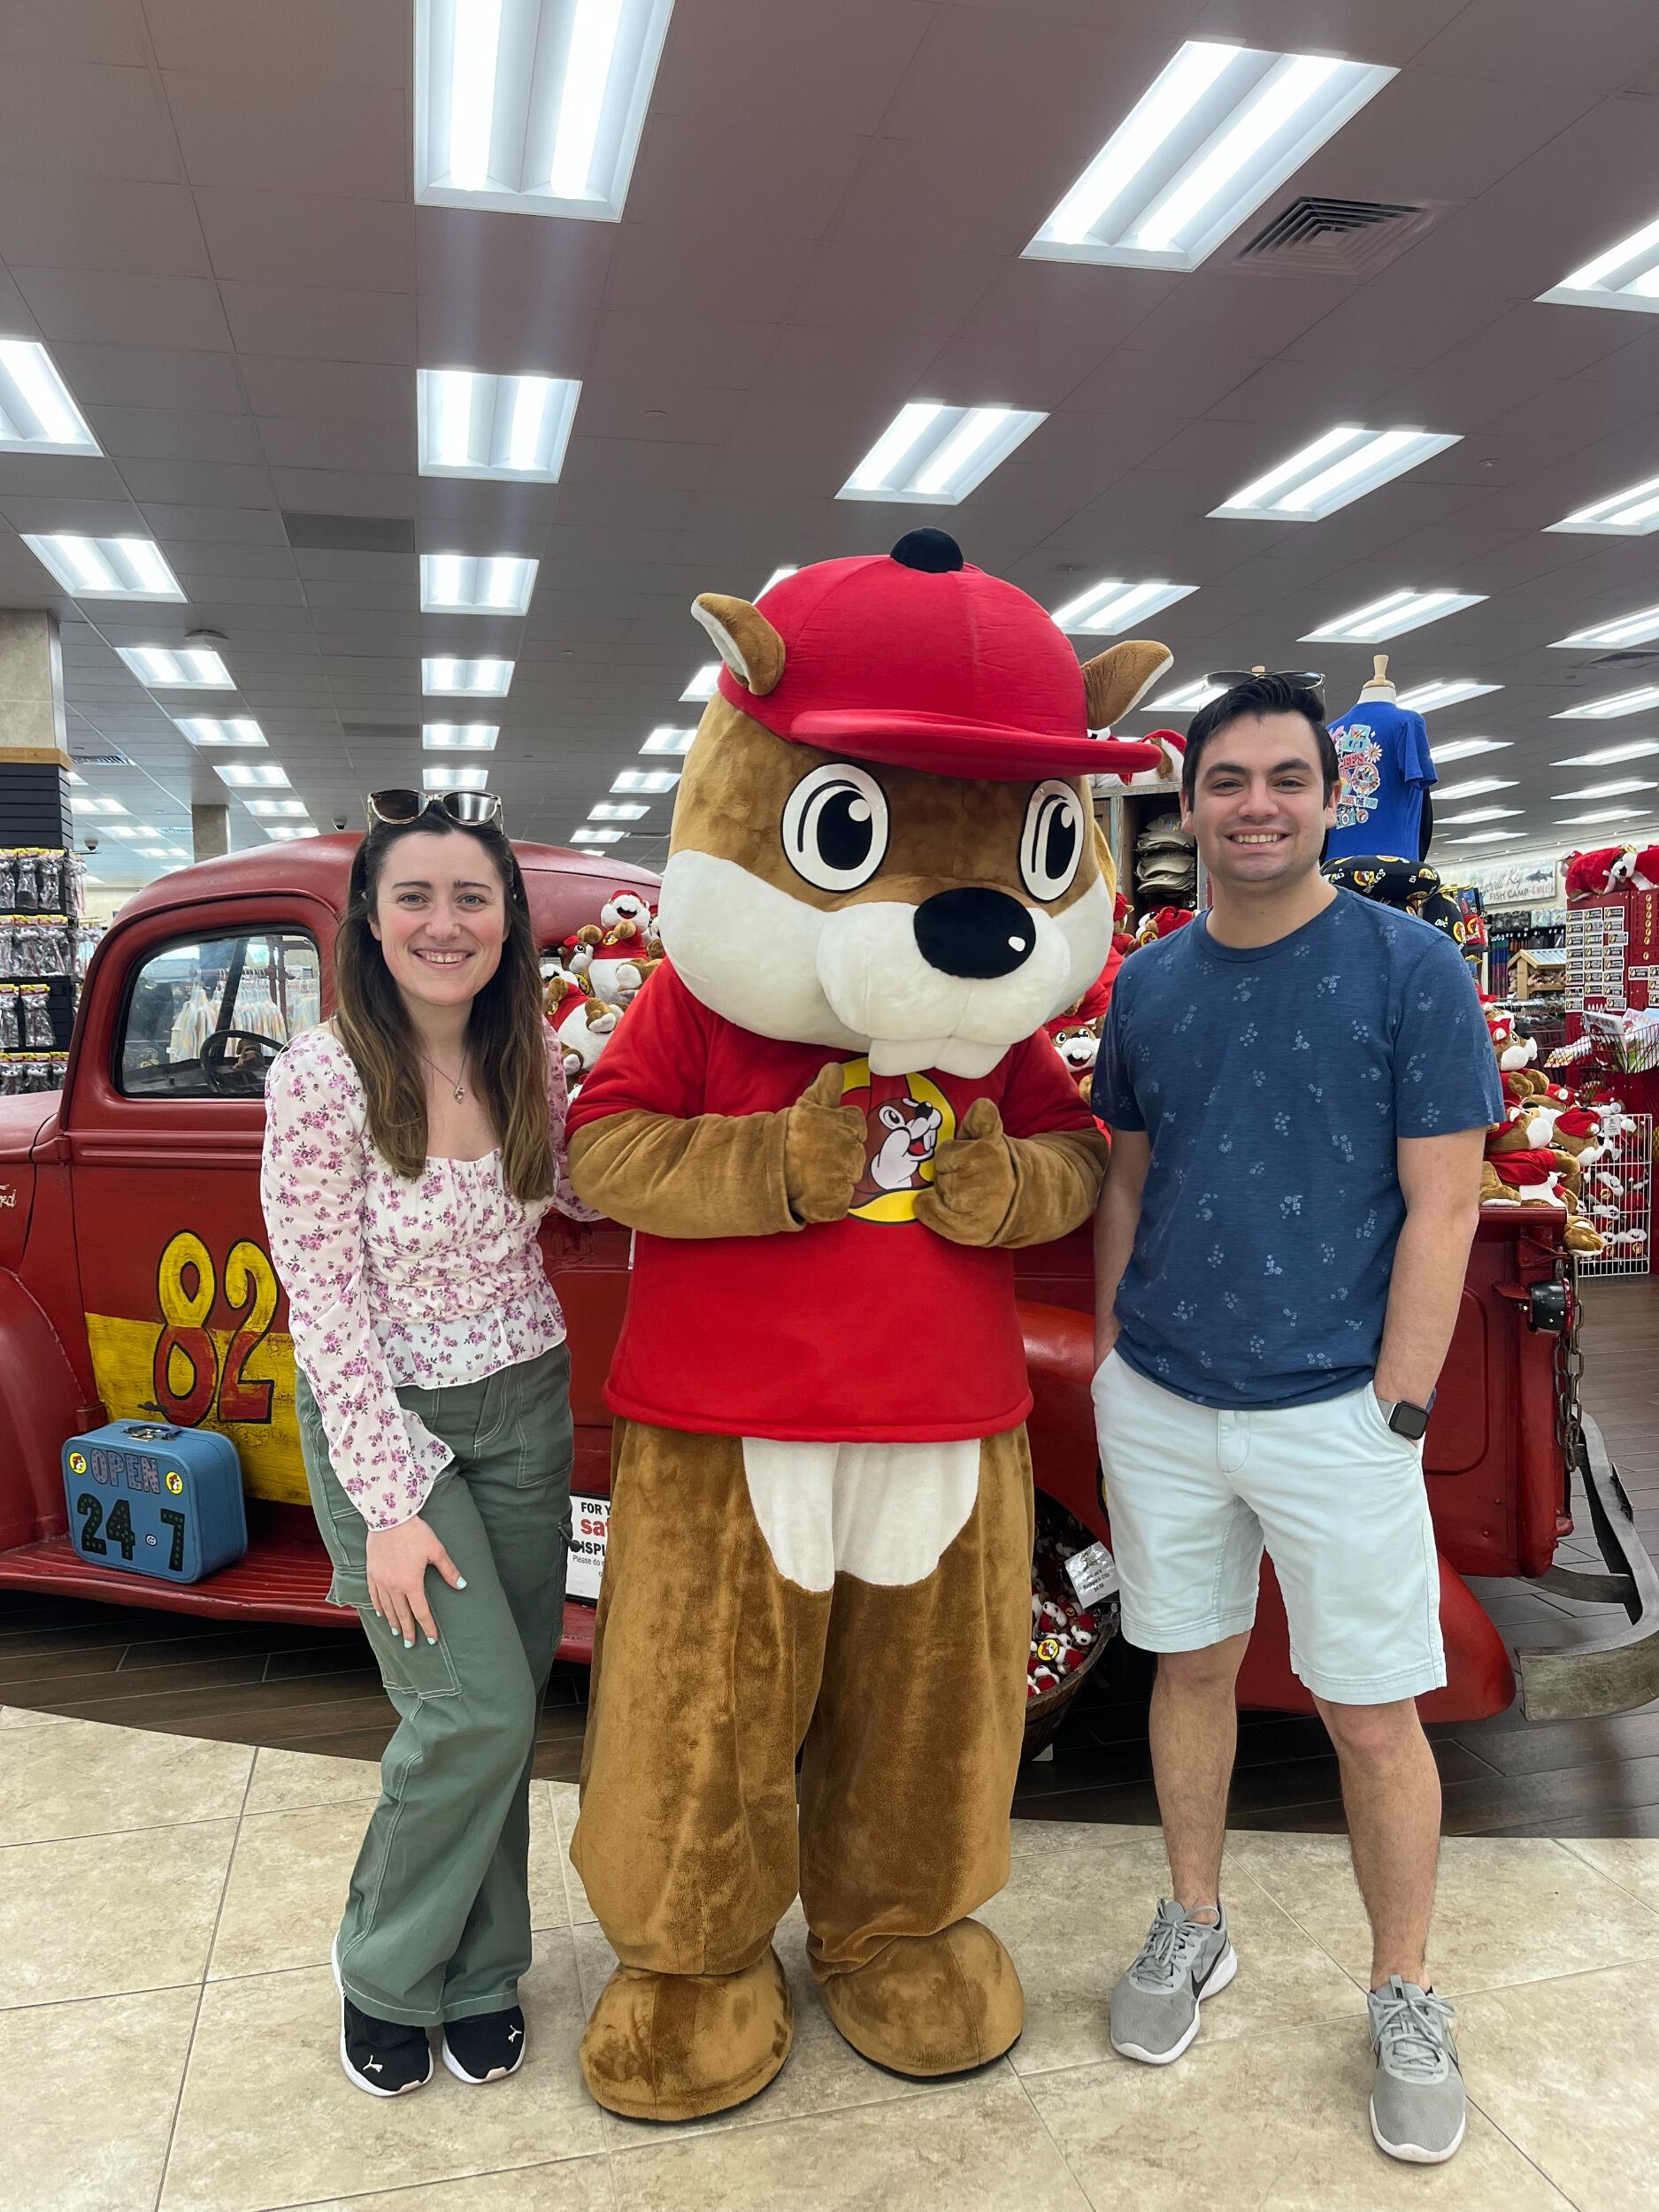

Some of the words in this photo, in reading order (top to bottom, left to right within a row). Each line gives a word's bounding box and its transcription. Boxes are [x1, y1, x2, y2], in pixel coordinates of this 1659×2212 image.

[1489, 891, 1505, 901] FISH
[1508, 888, 1529, 898] CAMP
[153, 1229, 280, 1428] 82
[90, 1448, 161, 1494] OPEN
[581, 1502, 602, 1515] FOR
[572, 1555, 592, 1565] Please
[593, 1557, 601, 1566] do
